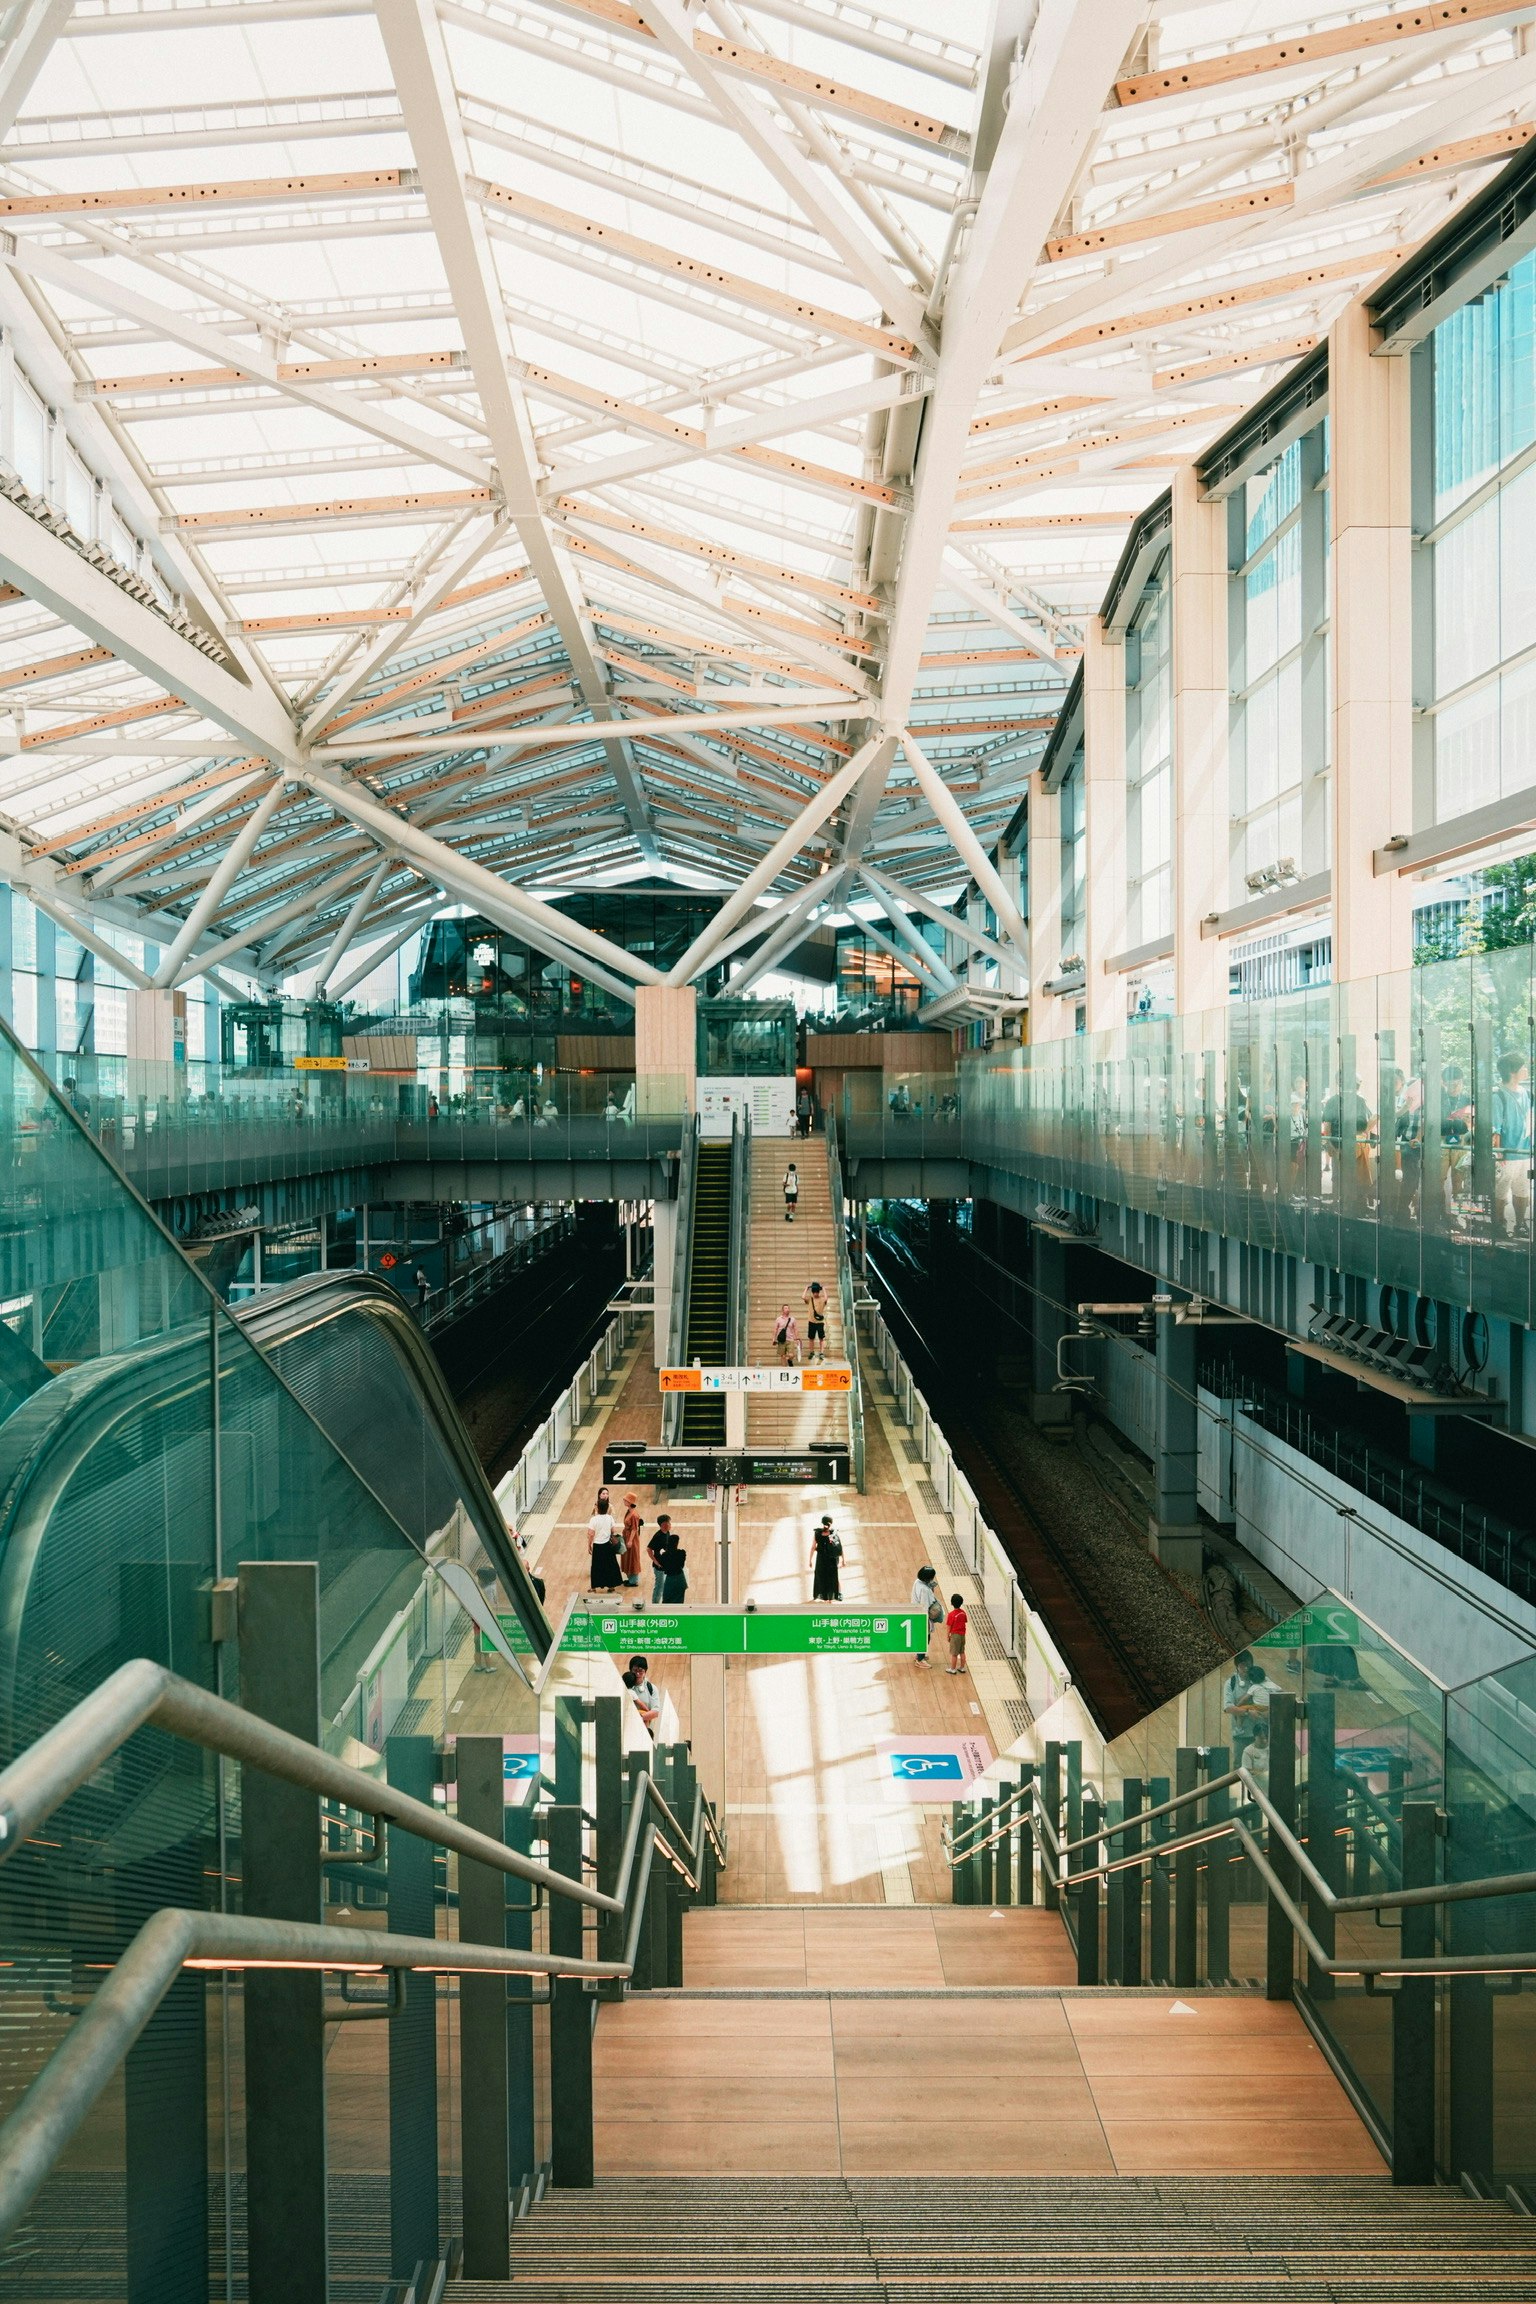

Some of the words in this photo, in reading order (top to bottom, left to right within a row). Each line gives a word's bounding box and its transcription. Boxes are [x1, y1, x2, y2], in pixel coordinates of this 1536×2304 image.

[612, 1459, 627, 1481] 2
[828, 1459, 838, 1481] 1
[900, 1619, 912, 1648] 1
